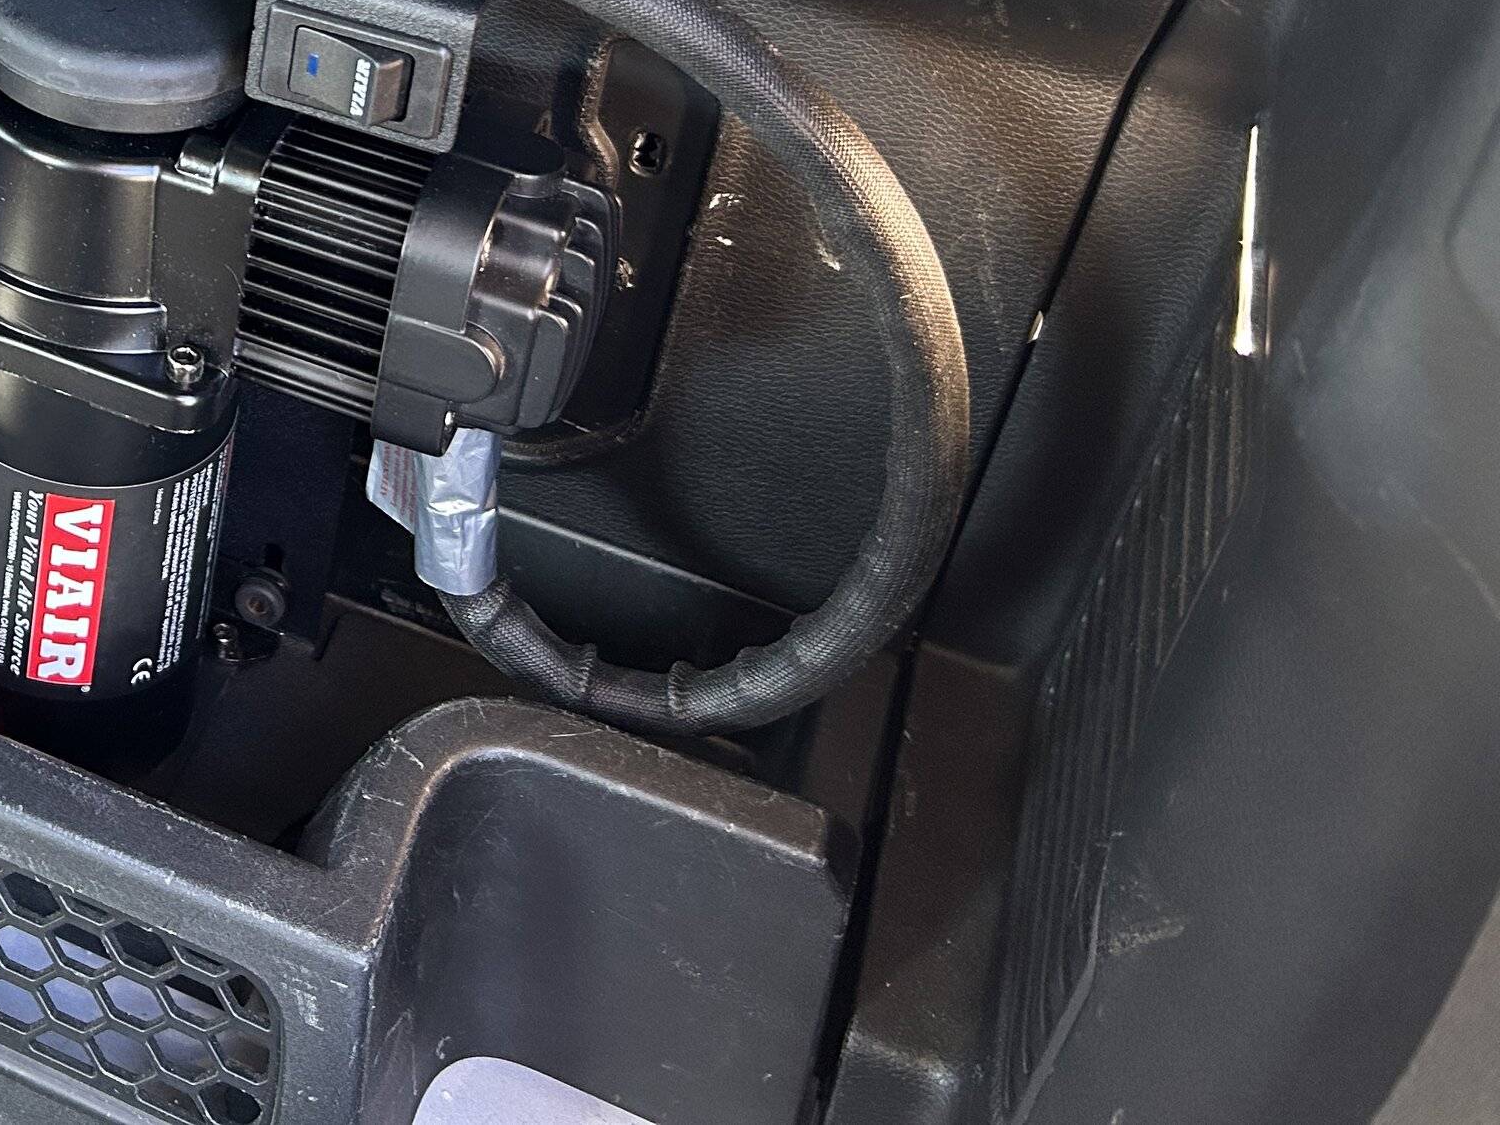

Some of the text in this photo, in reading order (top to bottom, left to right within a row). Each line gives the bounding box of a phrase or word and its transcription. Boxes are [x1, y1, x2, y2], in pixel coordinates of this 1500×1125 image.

[349, 58, 371, 116] VIAIR
[9, 489, 45, 676] Your Vital Air Source
[37, 504, 105, 679] VIAIR
